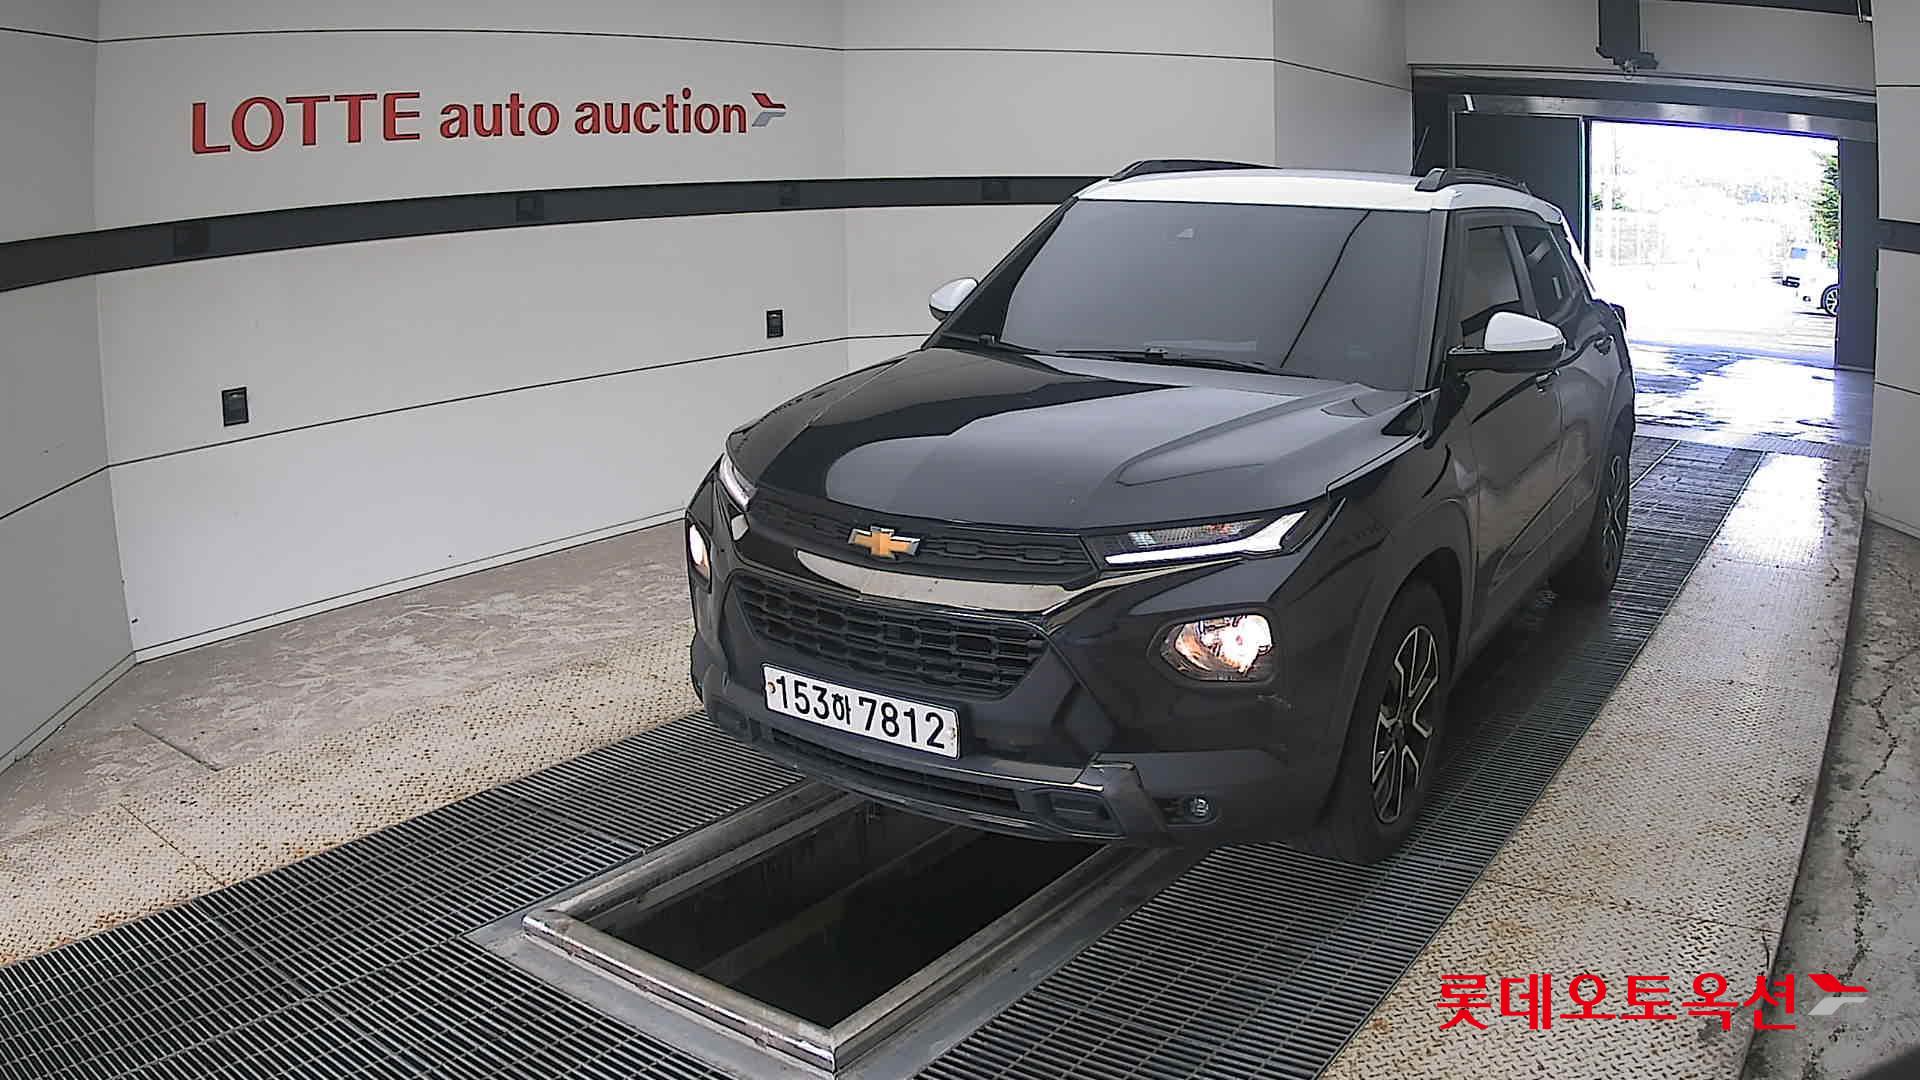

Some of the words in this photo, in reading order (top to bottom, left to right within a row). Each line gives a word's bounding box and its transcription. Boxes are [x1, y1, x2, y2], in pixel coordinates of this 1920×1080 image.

[192, 91, 420, 154] LOTTE
[439, 92, 560, 138] auto
[574, 87, 749, 134] auction
